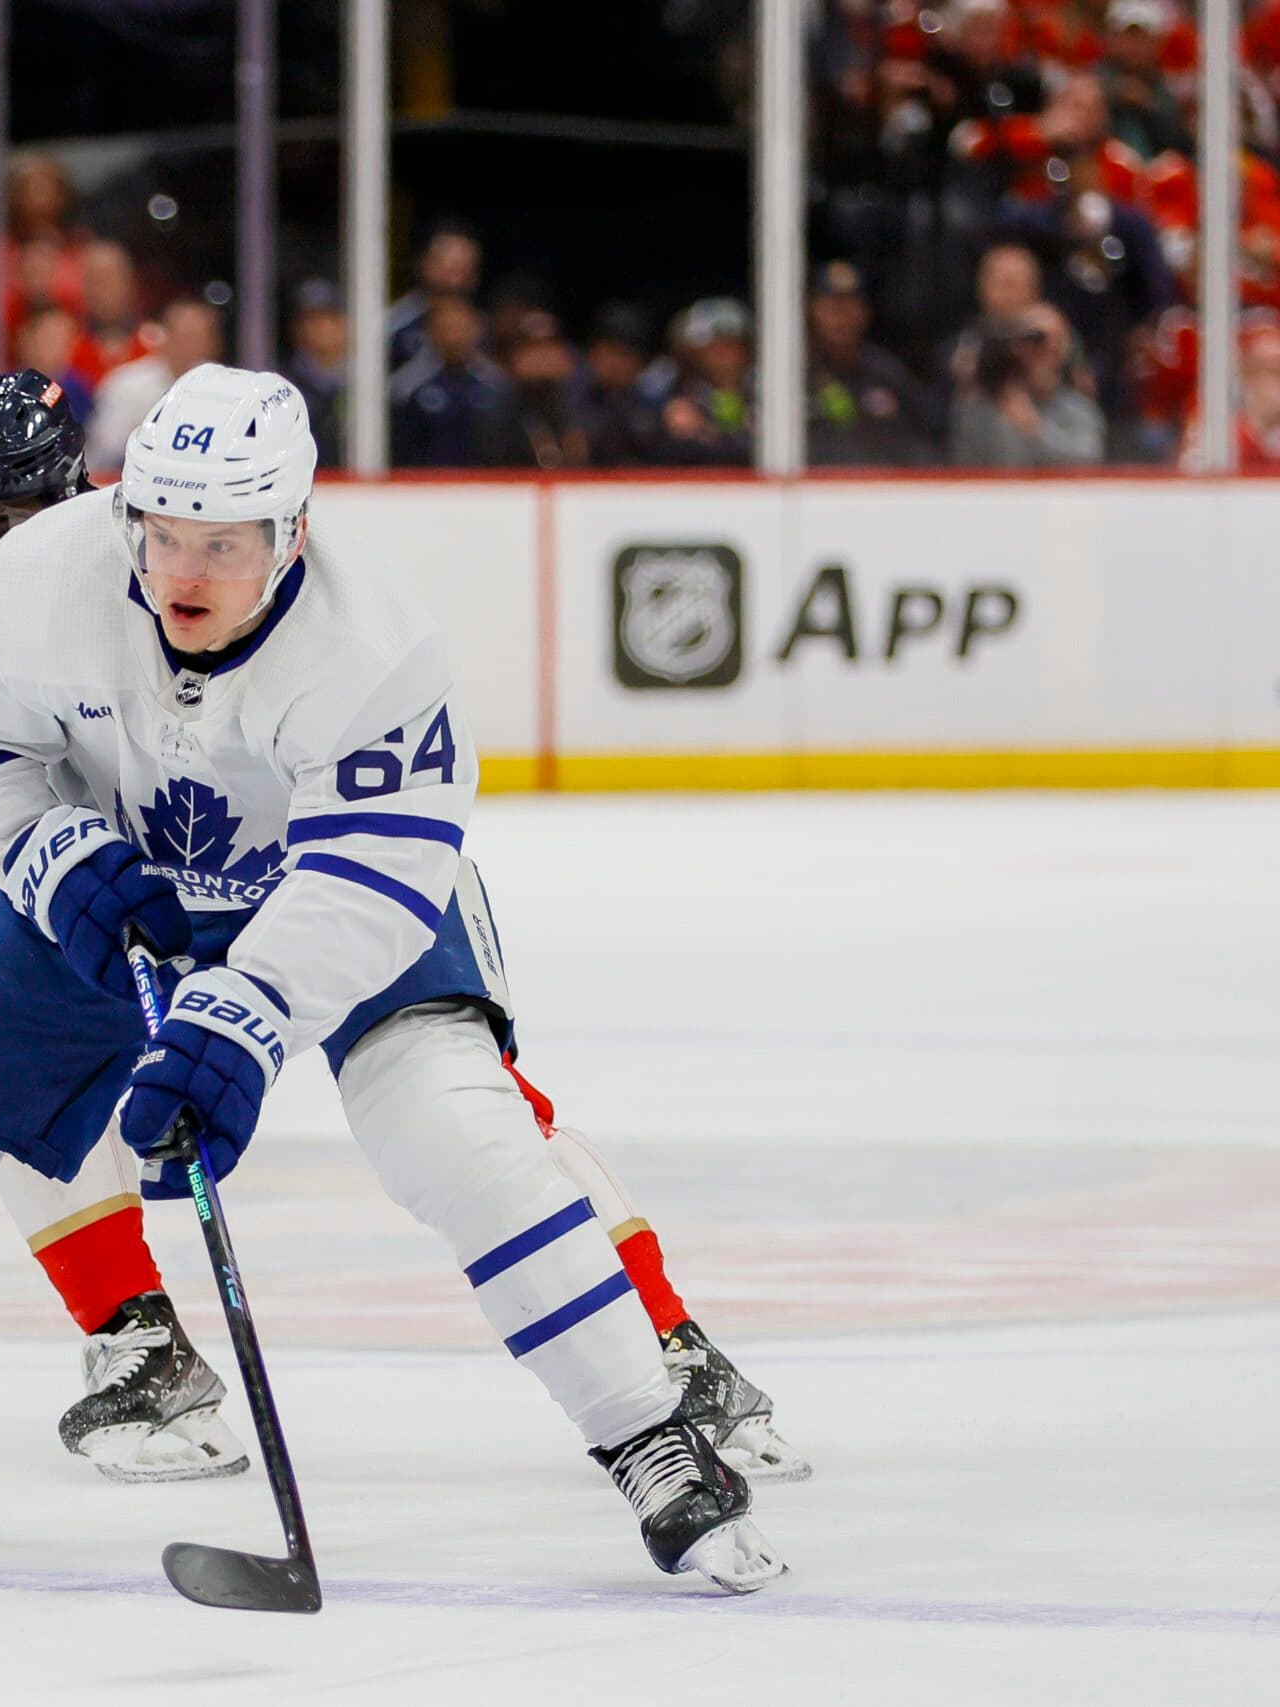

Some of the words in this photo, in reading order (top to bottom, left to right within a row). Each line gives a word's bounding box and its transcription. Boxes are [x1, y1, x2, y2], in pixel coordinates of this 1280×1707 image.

[171, 423, 215, 454] 64
[152, 475, 208, 491] BAUER
[336, 702, 456, 802] 64
[175, 990, 285, 1069] BAUE
[189, 1171, 212, 1223] BAUER
